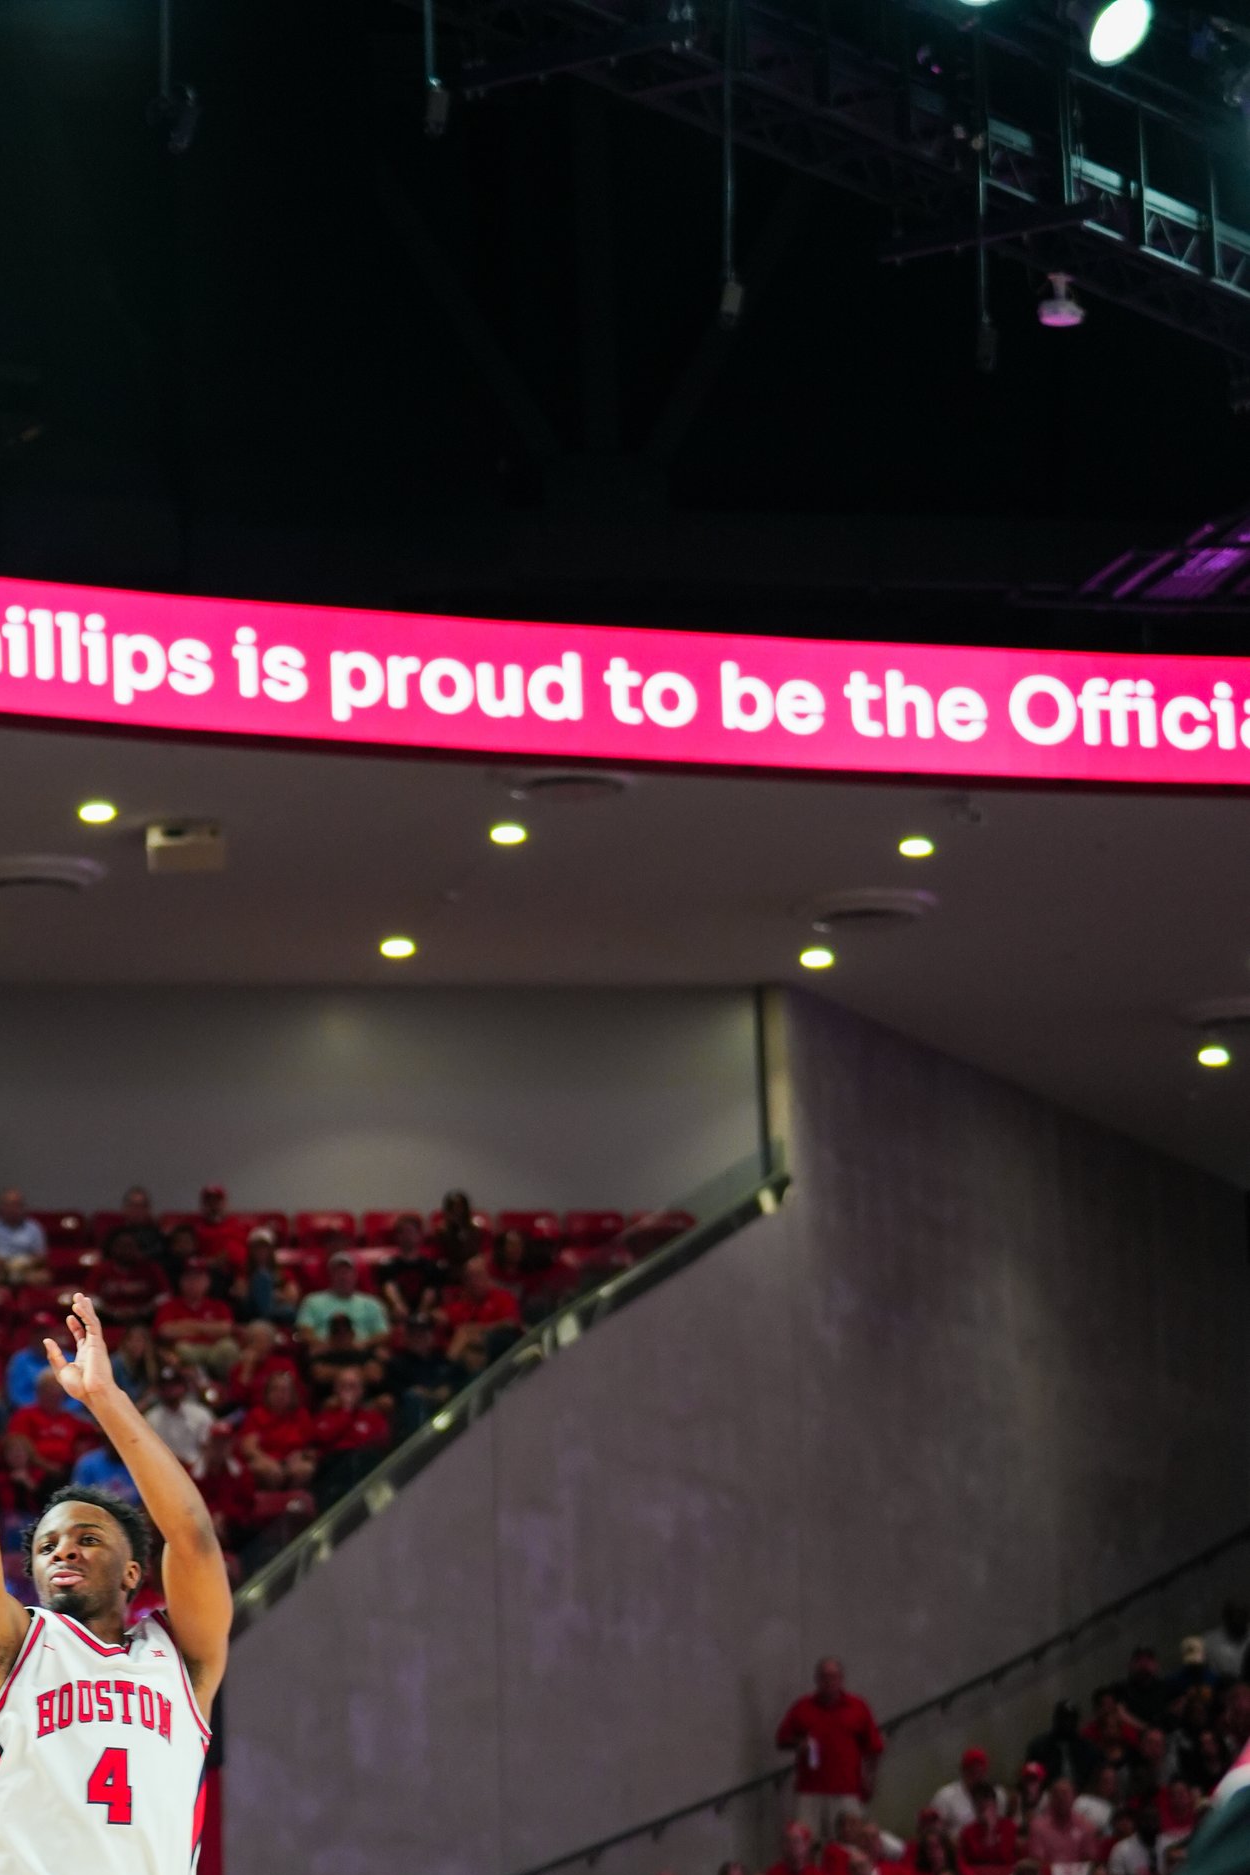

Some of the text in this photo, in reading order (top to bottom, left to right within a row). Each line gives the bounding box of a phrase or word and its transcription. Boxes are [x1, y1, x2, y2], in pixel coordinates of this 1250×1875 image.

[232, 627, 309, 703] is
[331, 642, 583, 722] proud
[603, 657, 698, 728] to
[719, 660, 826, 736] be
[843, 668, 989, 742] the
[1008, 674, 1250, 752] Offici
[36, 1679, 172, 1744] HOUSTON
[86, 1746, 132, 1826] 4
